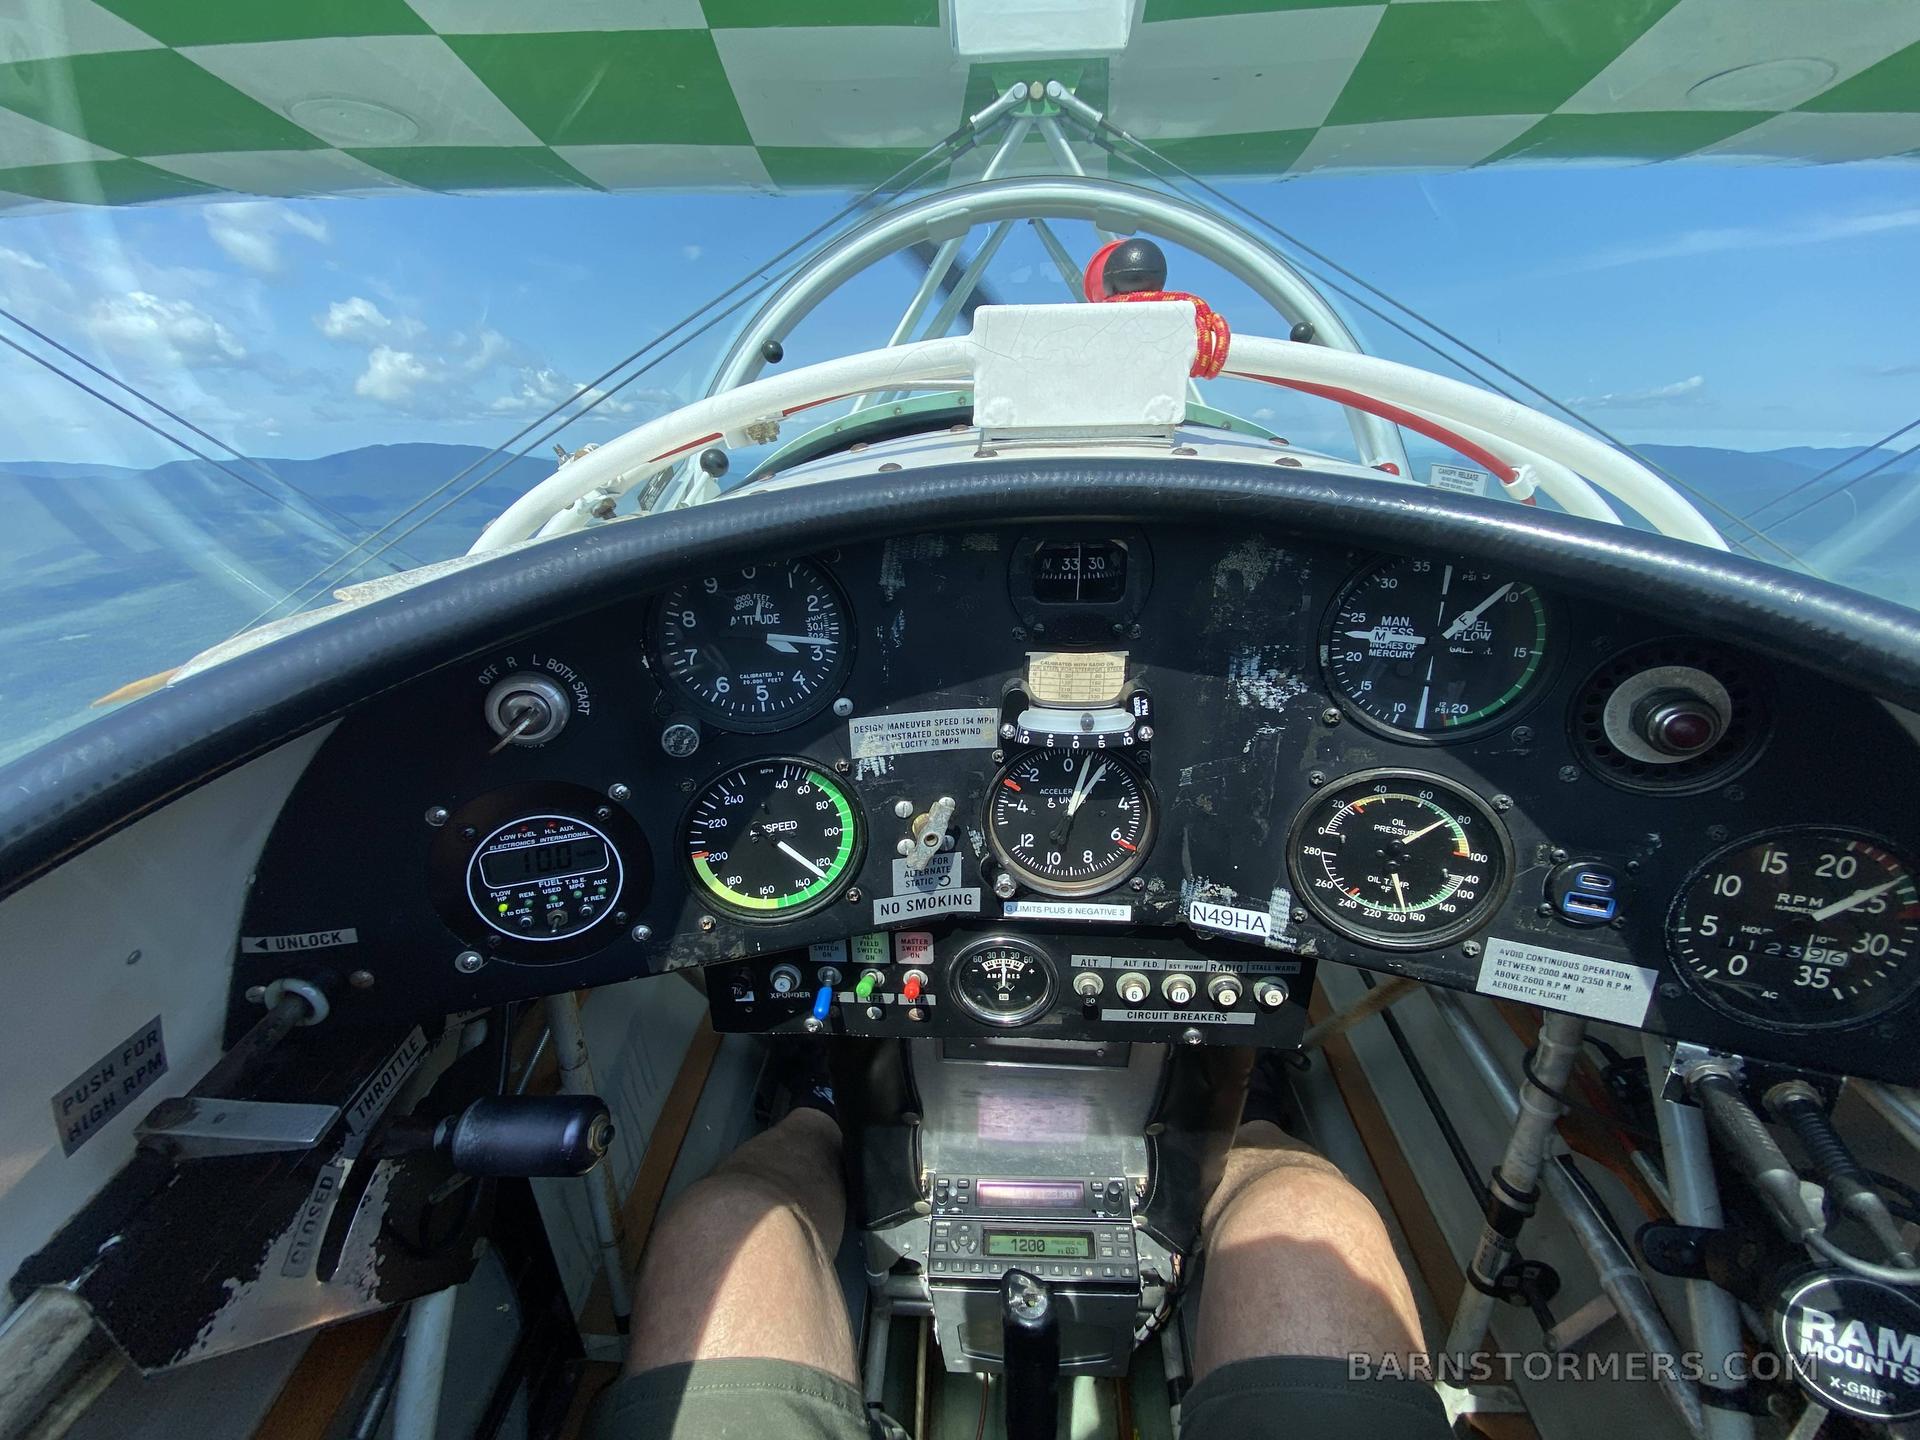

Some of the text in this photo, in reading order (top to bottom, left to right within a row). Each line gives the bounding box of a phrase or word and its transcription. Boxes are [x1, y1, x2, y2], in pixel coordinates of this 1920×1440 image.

[1062, 557, 1105, 571] 33 30
[1412, 561, 1430, 572] 35
[704, 577, 718, 593] 9
[1380, 578, 1398, 589] 30
[1505, 592, 1519, 602] 10
[807, 595, 820, 612] 2
[682, 611, 697, 627] 8
[1350, 613, 1366, 623] 25
[1381, 616, 1412, 627] MAN.
[1454, 631, 1492, 641] FLOW
[1369, 642, 1404, 650] INCHES
[684, 648, 698, 665] 7
[810, 645, 823, 660] 3
[1346, 652, 1362, 662] 20
[1368, 649, 1415, 659] MERCURY
[1513, 647, 1527, 657] 15
[506, 656, 518, 668] R
[532, 654, 541, 666] L
[478, 664, 500, 685] OFF
[546, 658, 577, 683] BOTH
[792, 670, 806, 685] 4
[716, 677, 730, 693] 6
[1361, 681, 1372, 690] 15
[756, 685, 769, 700] 5
[572, 681, 591, 716] START
[1393, 703, 1406, 713] 10
[1452, 704, 1469, 713] 20
[854, 716, 995, 734] DESIGN MANEUVER SPEED 154 MPH
[935, 728, 981, 737] CROSSWIND
[942, 737, 960, 745] MPH
[1020, 735, 1133, 748] 10 5 0 5 10
[1063, 758, 1074, 772] 0
[1021, 768, 1039, 782] -2
[775, 780, 788, 789] 40
[797, 785, 811, 795] 60
[1373, 785, 1387, 794] 40
[724, 795, 744, 805] 240
[1419, 791, 1433, 800] 60
[816, 800, 829, 810] 80
[1008, 800, 1028, 812] -4
[1118, 797, 1130, 810] 4
[1332, 800, 1344, 809] 20
[708, 817, 728, 829] 220
[1392, 818, 1406, 827] OIL
[1457, 816, 1471, 825] 80
[824, 827, 839, 837] 100
[1111, 828, 1121, 840] 6
[1318, 827, 1325, 835] 0
[489, 831, 591, 850] ELECTRONICS INTERNATIONAL
[1021, 834, 1034, 847] 12
[1083, 850, 1093, 863] 8
[1303, 846, 1321, 856] 280
[709, 852, 728, 862] 200
[933, 856, 949, 864] FOR
[1047, 852, 1061, 865] 10
[1470, 853, 1488, 863] 100
[816, 858, 830, 868] 120
[1760, 851, 1789, 875] 15
[1815, 854, 1857, 879] 20
[904, 865, 951, 879] ALTERNATE
[538, 879, 562, 887] FUEL
[727, 875, 742, 886] 180
[795, 878, 811, 888] 140
[905, 877, 934, 888] STATIC
[1315, 879, 1333, 889] 260
[1367, 875, 1382, 885] OIL
[1464, 875, 1479, 884] 40
[542, 887, 562, 895] USED
[759, 885, 775, 895] 160
[1713, 874, 1742, 897] 10
[490, 890, 511, 898] FLOW
[1457, 890, 1474, 900] 100
[880, 894, 972, 916] NO SMOKING
[1338, 898, 1357, 909] 240
[1439, 903, 1456, 913] 140
[1005, 905, 1013, 913] G
[1014, 905, 1042, 913] LIMITS
[1044, 906, 1066, 914] PLUS
[1067, 907, 1073, 915] 6
[1075, 907, 1117, 916] NEGATIVE
[1363, 908, 1382, 918] 220
[1193, 904, 1267, 933] N49HA
[1387, 912, 1406, 922] 200
[1409, 912, 1425, 922] 180
[1700, 915, 1719, 936] 5
[275, 930, 343, 951] UNLOCK
[1851, 932, 1889, 956] 30
[1080, 959, 1098, 967] ALT
[1499, 948, 1524, 959] AVOID
[1526, 953, 1580, 970] CONTINUOUS
[1210, 964, 1243, 972] RADIO
[1727, 955, 1748, 976] 0
[1497, 959, 1536, 973] BETWEEN
[1538, 967, 1560, 977] 2000
[1562, 972, 1580, 982] AND
[1581, 976, 1603, 987] 2350
[1793, 965, 1831, 989] 35
[1492, 980, 1537, 995] AEROBATIC
[1495, 970, 1520, 981] ABOVE
[1523, 976, 1544, 986] 2600
[1576, 986, 1585, 994] IN
[770, 991, 811, 999] XPONDER
[1174, 991, 1186, 1000] 10
[1761, 990, 1778, 999] AC
[1127, 1011, 1228, 1022] CIRCUIT BREAKERS
[62, 1030, 157, 1116] PUSH FOR
[355, 1036, 420, 1120] THROTTLE
[68, 1052, 163, 1142] HIGH RPM
[290, 1174, 335, 1266] CLOSED
[1010, 1238, 1046, 1253] 1200
[1801, 1306, 1920, 1368] RAM
[1800, 1336, 1920, 1386] MOUNTS
